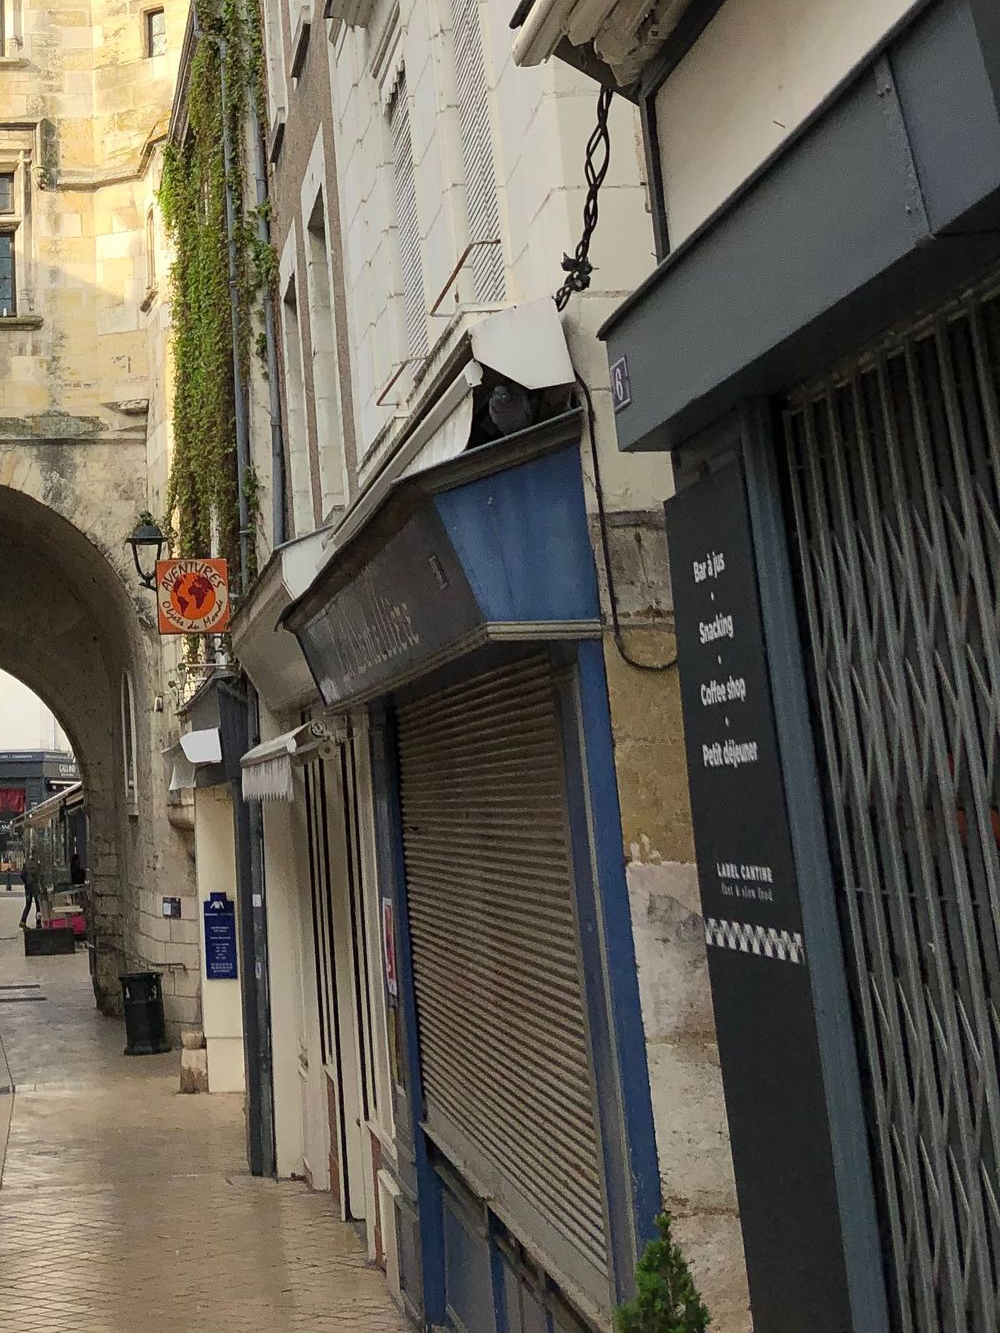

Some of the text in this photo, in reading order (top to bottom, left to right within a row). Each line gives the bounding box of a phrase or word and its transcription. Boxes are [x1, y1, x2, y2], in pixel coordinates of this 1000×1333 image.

[614, 367, 625, 402] 6
[162, 561, 226, 593] AVENTURES
[693, 551, 725, 583] Bar à jus
[699, 612, 734, 645] Snacking
[701, 675, 746, 706] Coffee shop
[702, 739, 758, 769] Petit déjeuner
[716, 862, 774, 883] LABEL CANTINE
